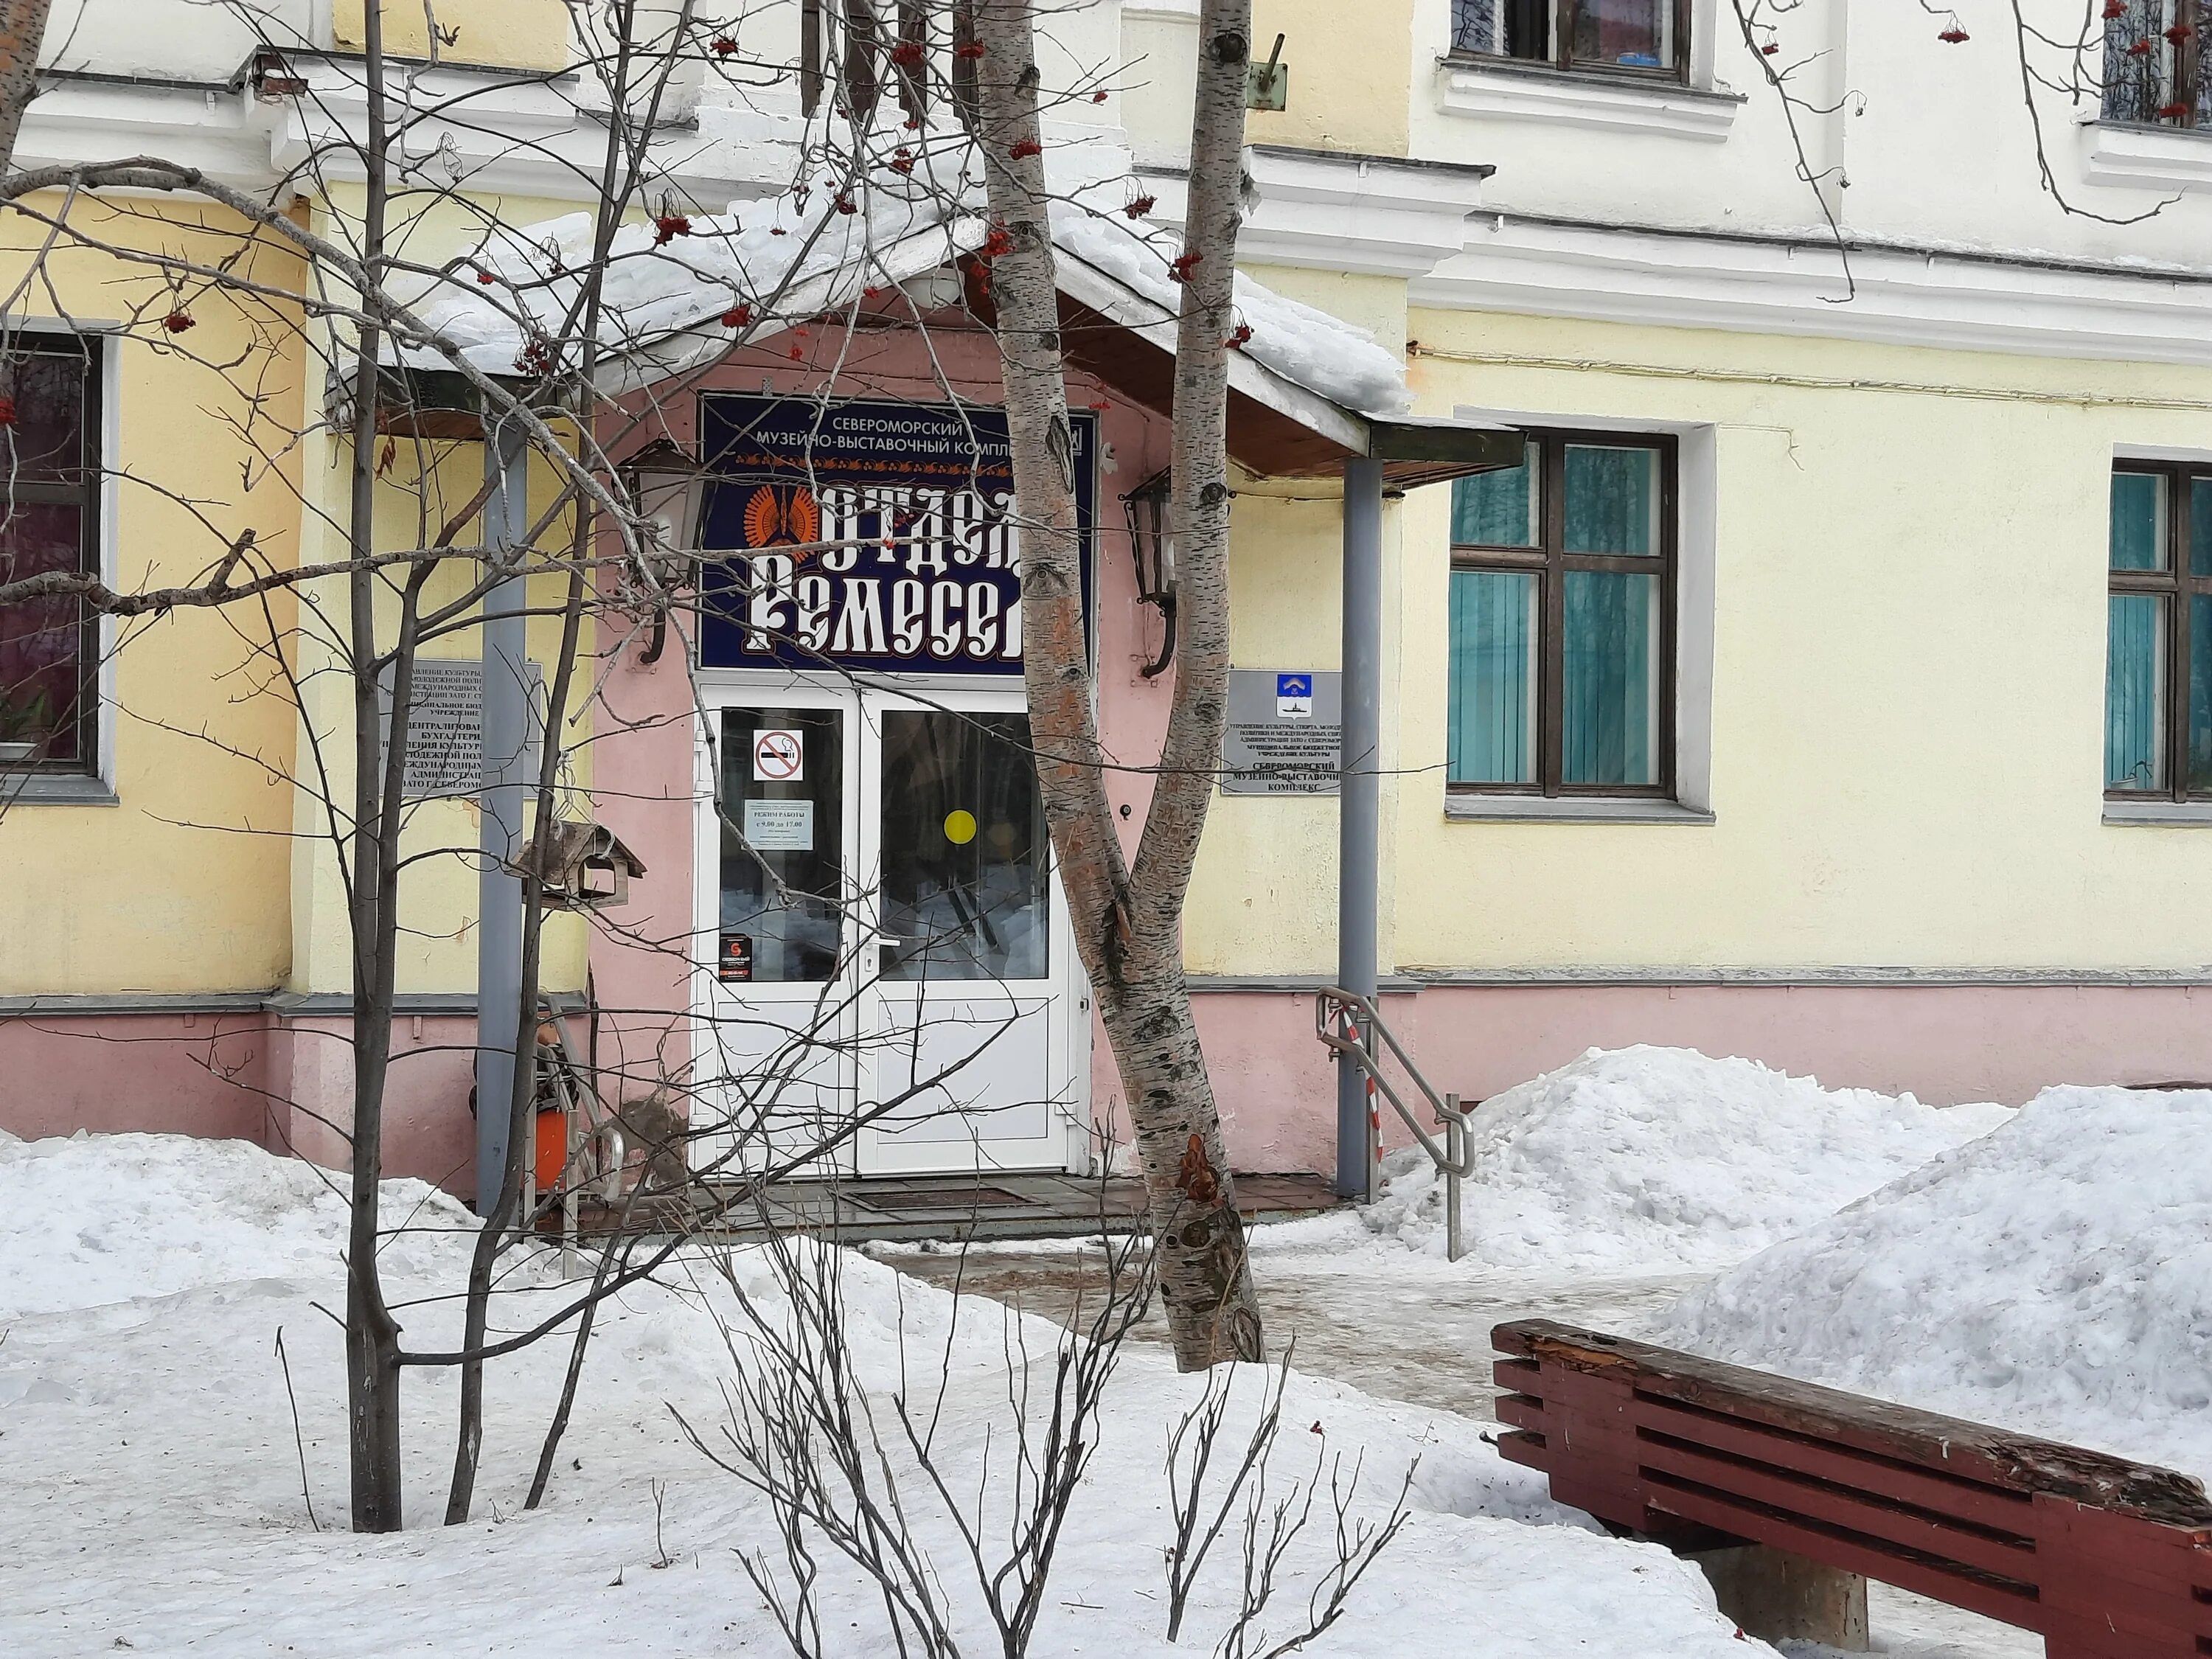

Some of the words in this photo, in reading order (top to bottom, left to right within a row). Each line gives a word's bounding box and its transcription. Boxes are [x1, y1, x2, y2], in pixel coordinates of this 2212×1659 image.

[832, 417, 962, 437] СЕВЕРОМОРСКИЙ
[757, 430, 950, 453] МУЗЕЙНО-ВЫСТАВОЧНЫЙ
[954, 441, 1011, 456] КОМПЛ
[1252, 761, 1335, 771] СЕВЕРОМОРСКИЙ
[411, 771, 481, 779] АДМИНИСТРАЦ
[1233, 771, 1340, 782] МУЗЕЙНО-ВЫСТАВОЧН
[1267, 783, 1321, 792] КОМПЛЕКС
